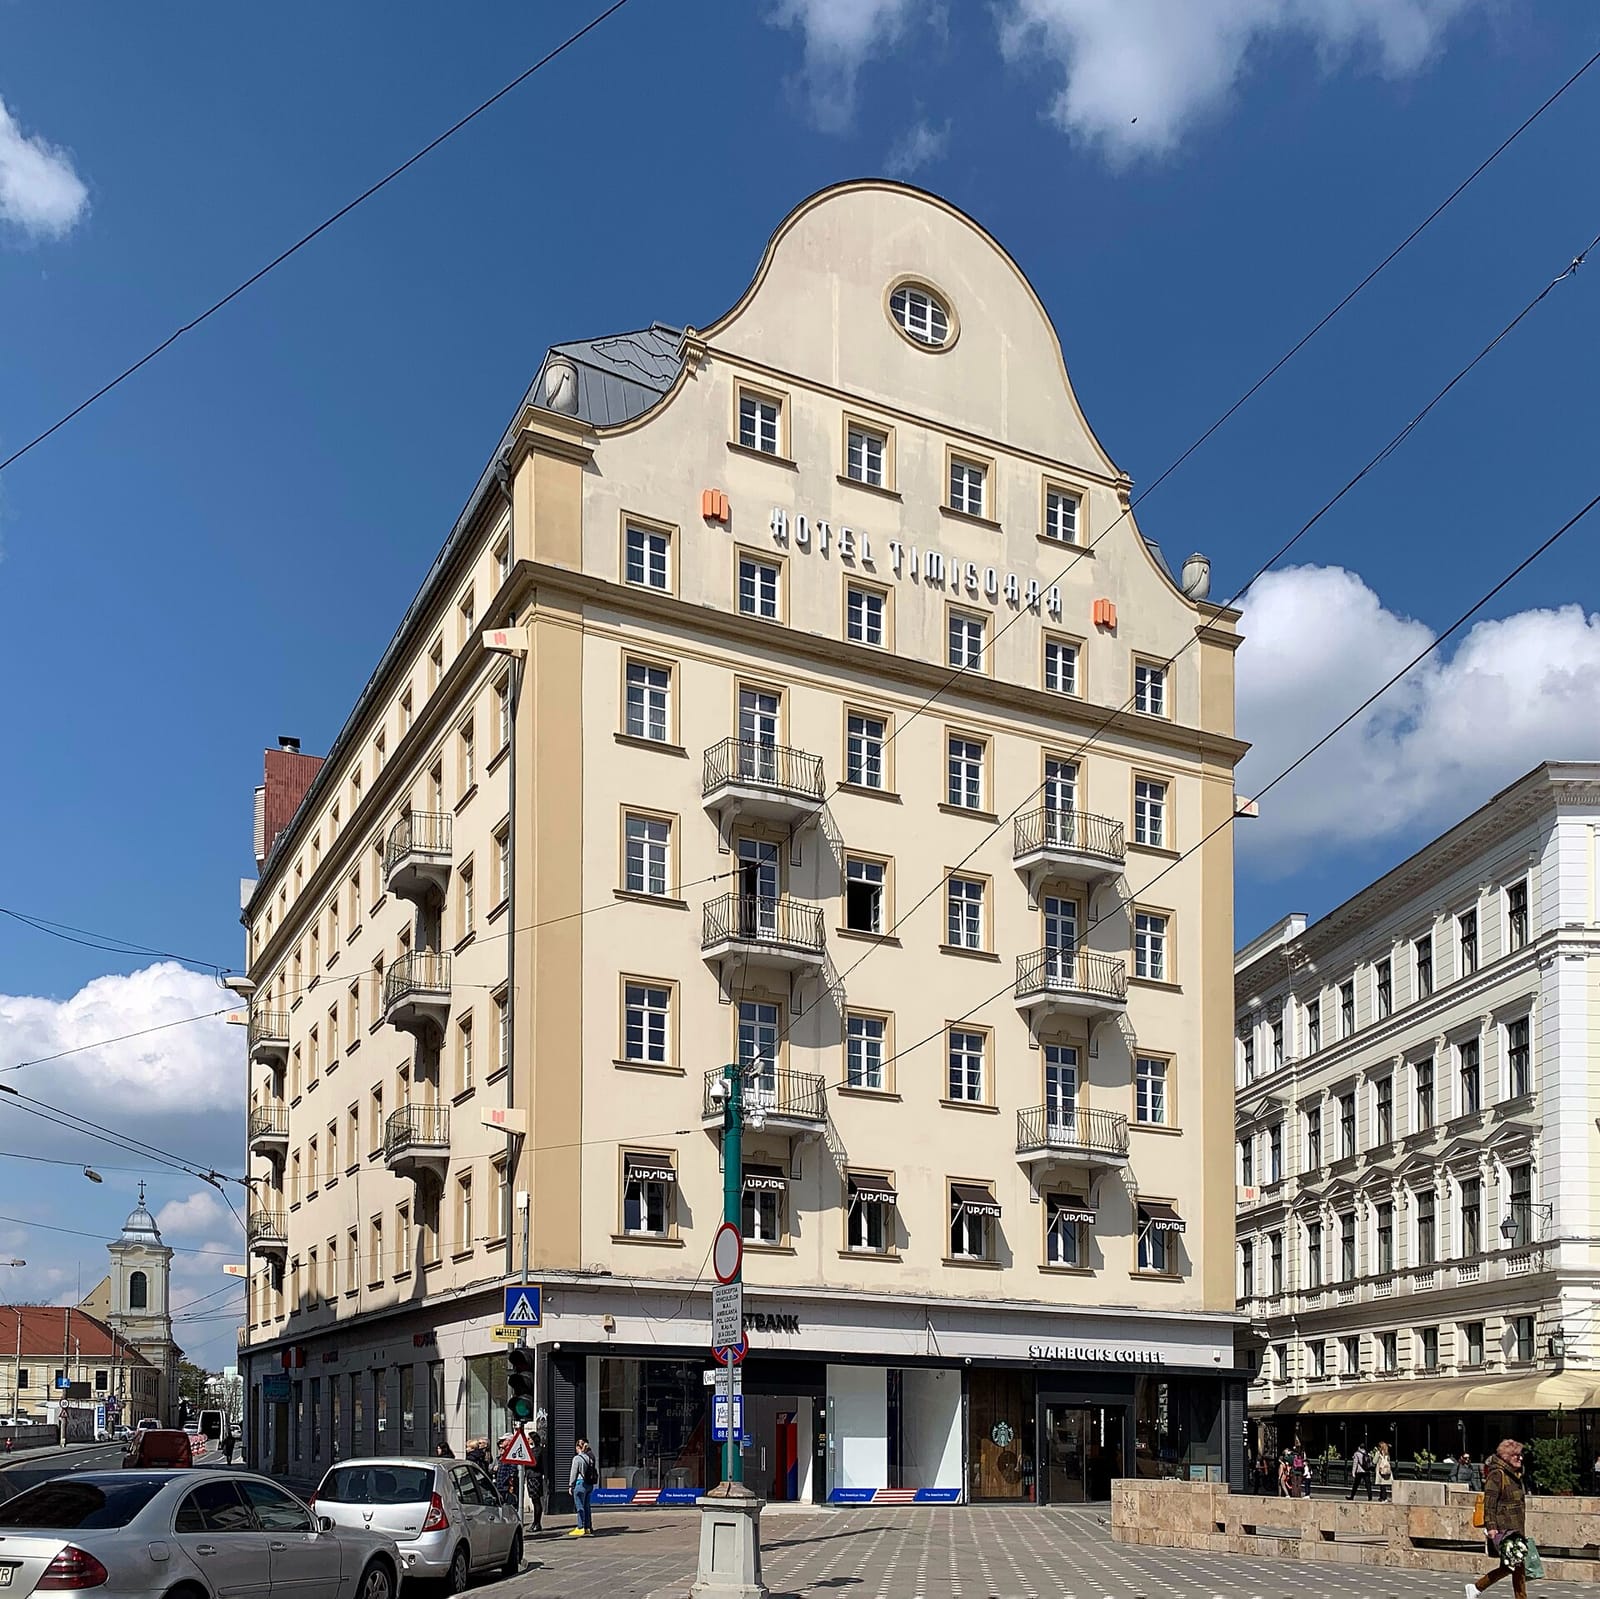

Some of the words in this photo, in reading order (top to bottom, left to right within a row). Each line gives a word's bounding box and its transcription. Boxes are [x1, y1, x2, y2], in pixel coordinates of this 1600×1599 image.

[771, 507, 875, 561] HOTEL
[889, 540, 1061, 613] TIMISOARA
[634, 1169, 675, 1182] UPSIDE
[747, 1179, 785, 1190] UPSIDE
[860, 1192, 895, 1204] UPSIDE
[966, 1205, 1000, 1217] UPSIDE
[1063, 1213, 1094, 1224] UPSIDE
[1155, 1221, 1185, 1232] UPSIDE
[1028, 1344, 1111, 1361] STARBUCKS
[1114, 1350, 1166, 1364] COFFEE
